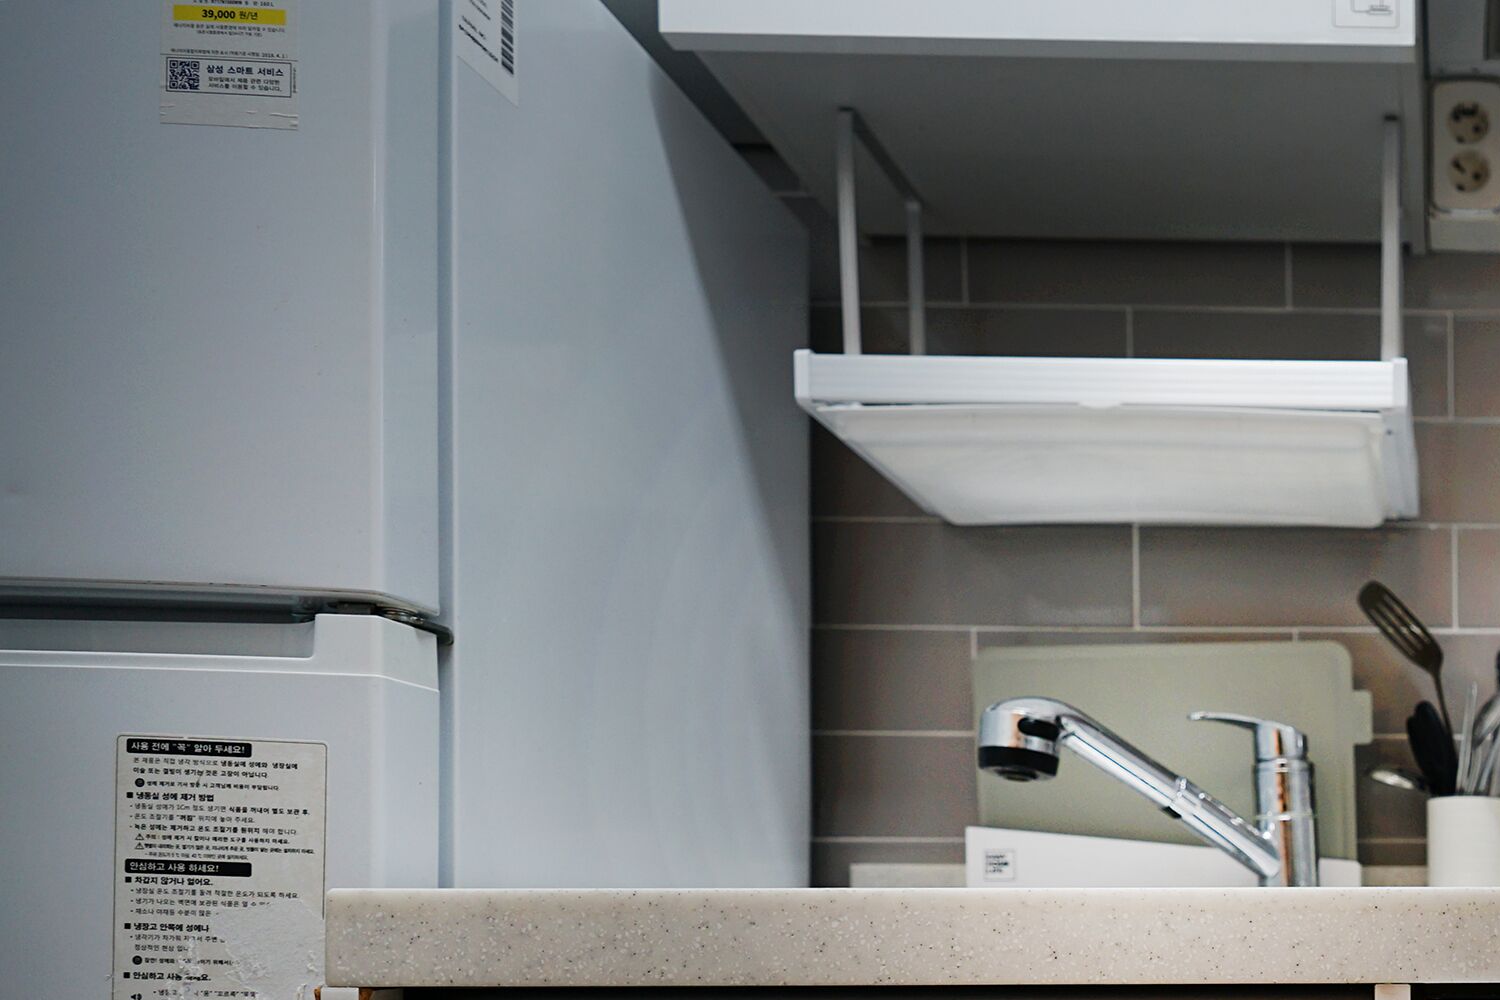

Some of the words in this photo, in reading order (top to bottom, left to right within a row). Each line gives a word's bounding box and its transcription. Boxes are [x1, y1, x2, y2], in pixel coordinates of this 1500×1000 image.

[201, 9, 236, 19] 39,000
[239, 11, 259, 20] 원/년
[206, 65, 224, 74] 삼성
[227, 66, 254, 75] 스마트
[256, 67, 284, 77] 서비스
[131, 742, 149, 751] 사용
[151, 742, 170, 751] 전에
[193, 744, 212, 753] 알아
[215, 744, 245, 754] 두세요!
[136, 792, 159, 800] 냉동실
[162, 792, 178, 801] 성에
[180, 793, 196, 801] 제거
[198, 794, 214, 802] 방법
[129, 861, 165, 871] 안심하고
[167, 863, 186, 872] 사용
[188, 864, 219, 873] 하세요!
[134, 876, 158, 885] 차갑지
[160, 877, 185, 885] 않거나
[187, 878, 213, 886] 얼어요.
[133, 923, 157, 931] 냉장고
[159, 923, 183, 932] 안쪽에
[186, 924, 209, 933] 성에나
[133, 972, 165, 981] 안심하고
